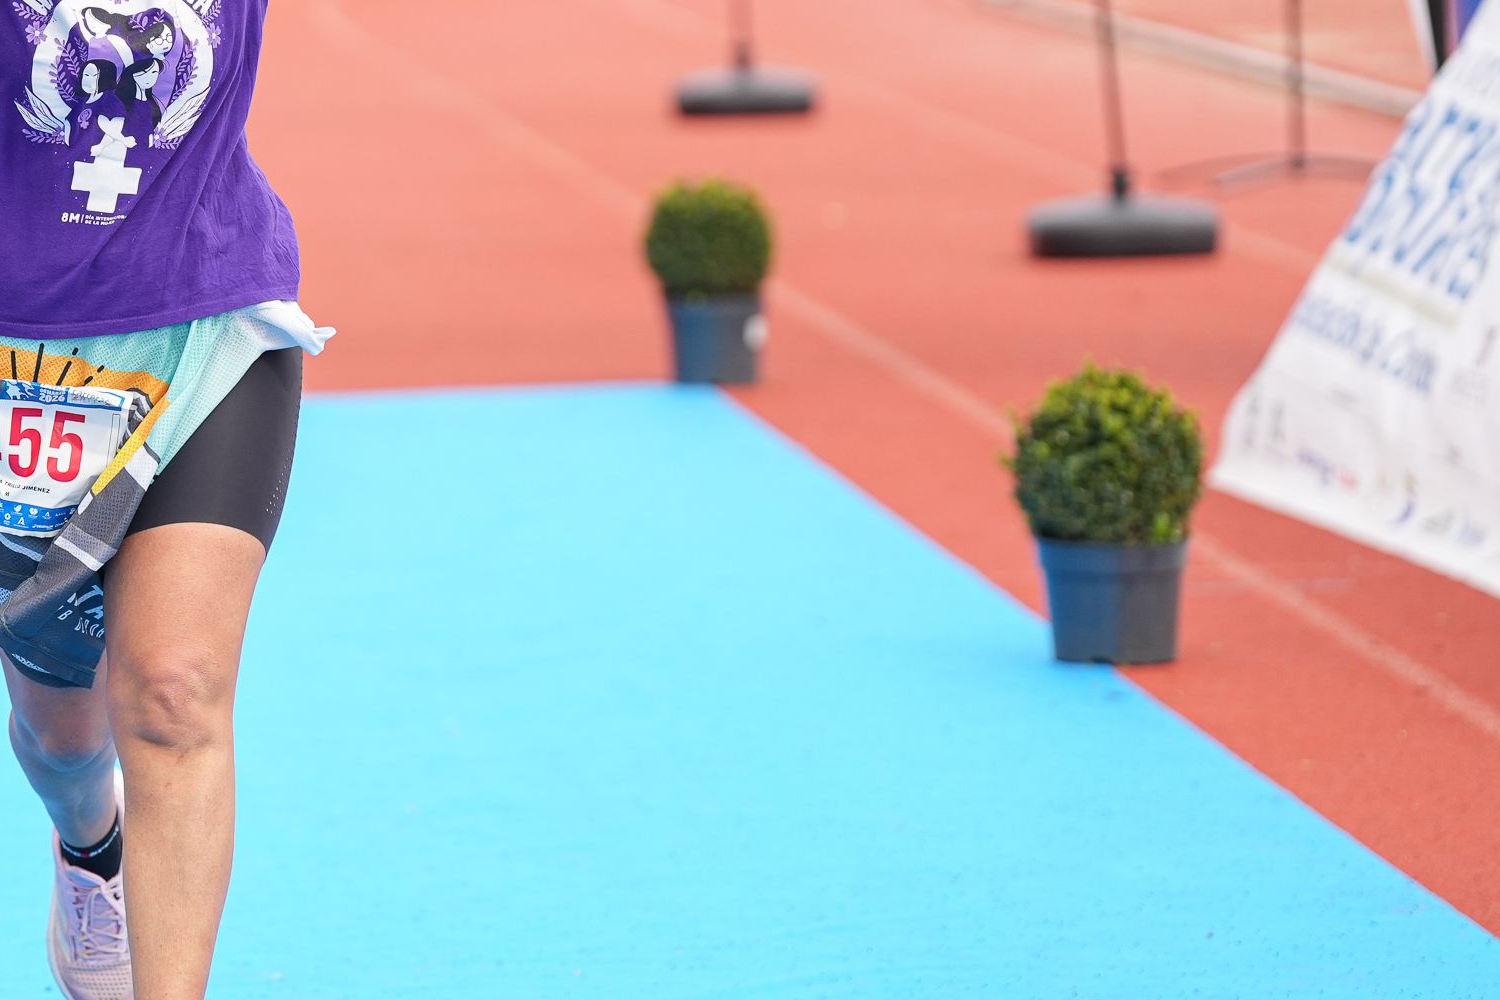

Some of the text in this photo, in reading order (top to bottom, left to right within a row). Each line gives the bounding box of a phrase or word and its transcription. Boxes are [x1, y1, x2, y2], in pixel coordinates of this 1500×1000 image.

[61, 212, 81, 224] 8M
[39, 393, 66, 404] 2026
[22, 484, 51, 494] JIMÉNEZ
